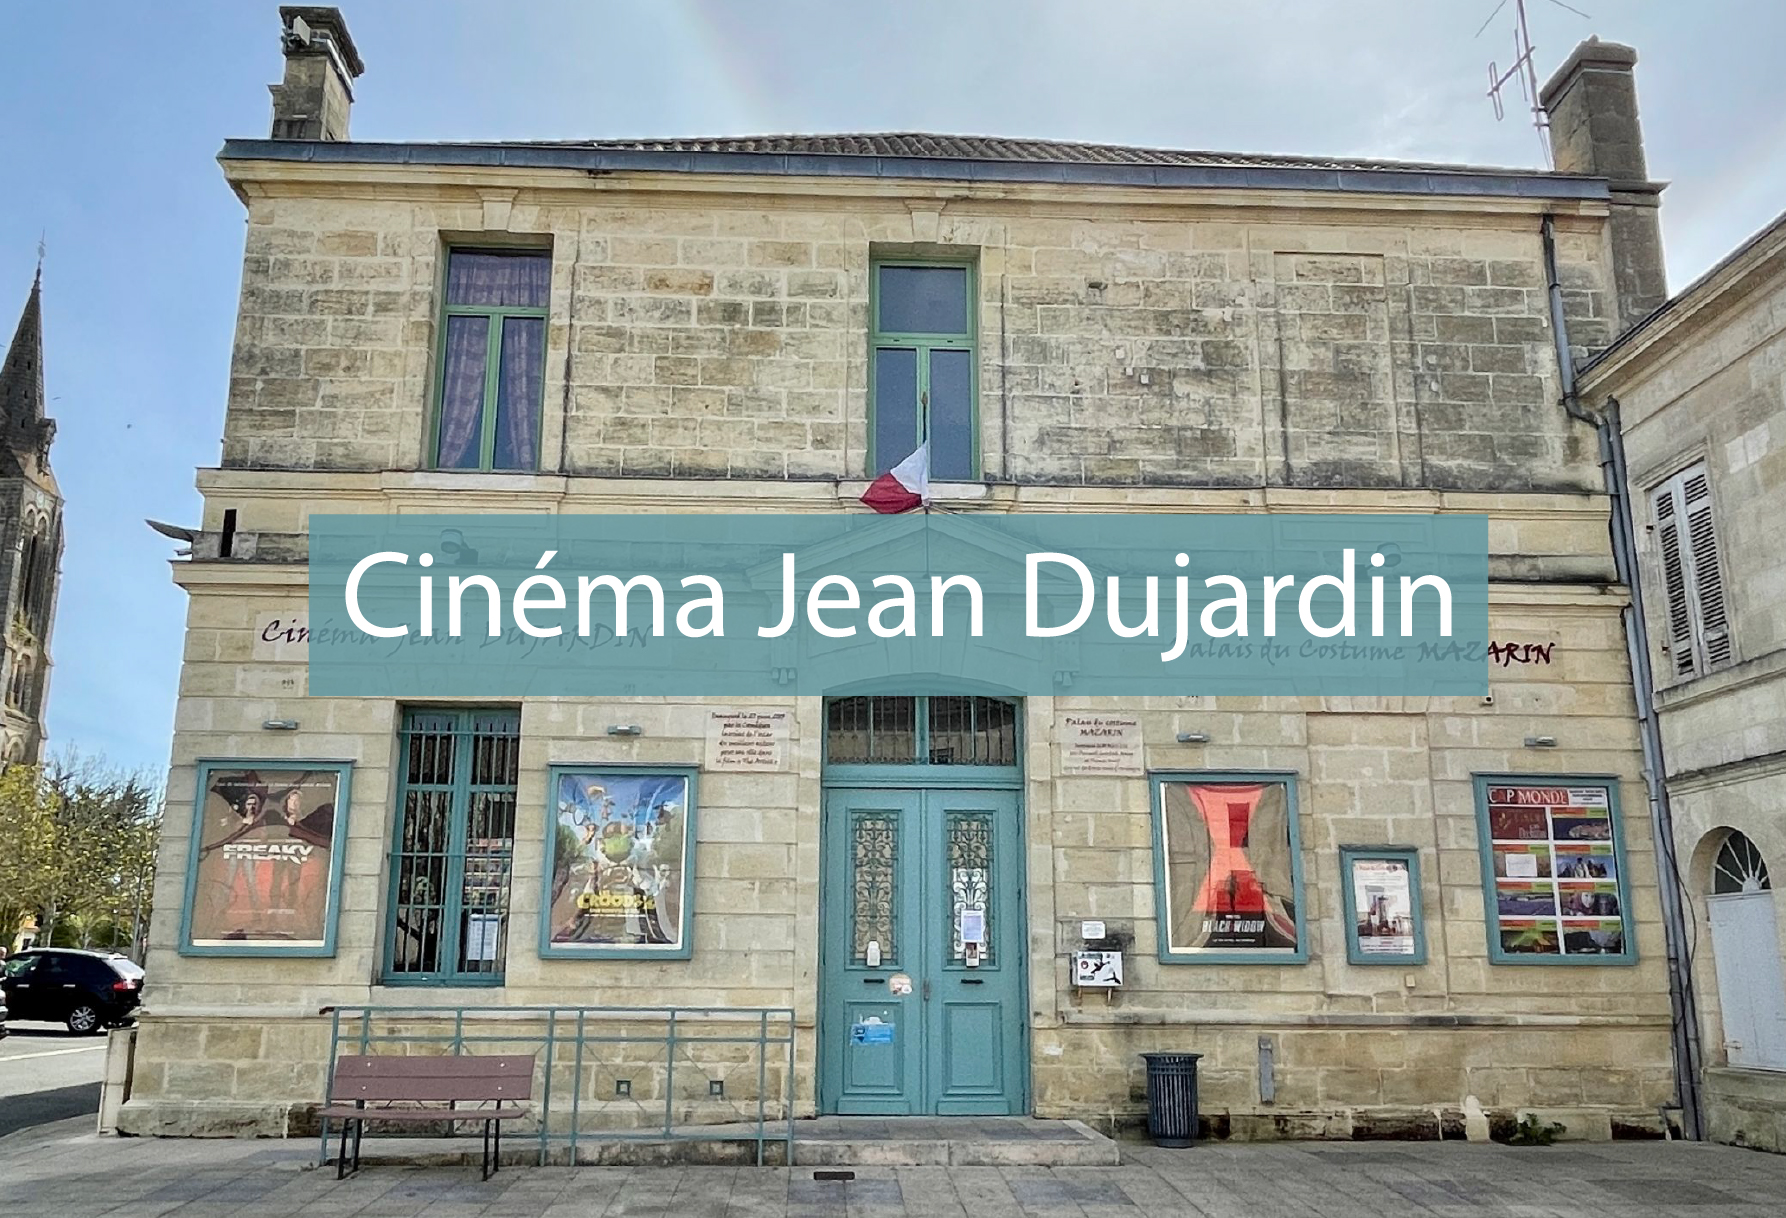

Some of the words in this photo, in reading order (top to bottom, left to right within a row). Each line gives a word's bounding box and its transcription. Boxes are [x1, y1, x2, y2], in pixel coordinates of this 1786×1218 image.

[261, 617, 379, 646] Cinéma
[1169, 636, 1253, 659] alais
[1260, 637, 1290, 666] du
[1299, 638, 1406, 661] Costume
[1417, 640, 1555, 668] MAZARIN
[223, 844, 314, 865] FREAKY
[1202, 920, 1231, 933] BLACK
[1234, 920, 1265, 933] WIDOW
